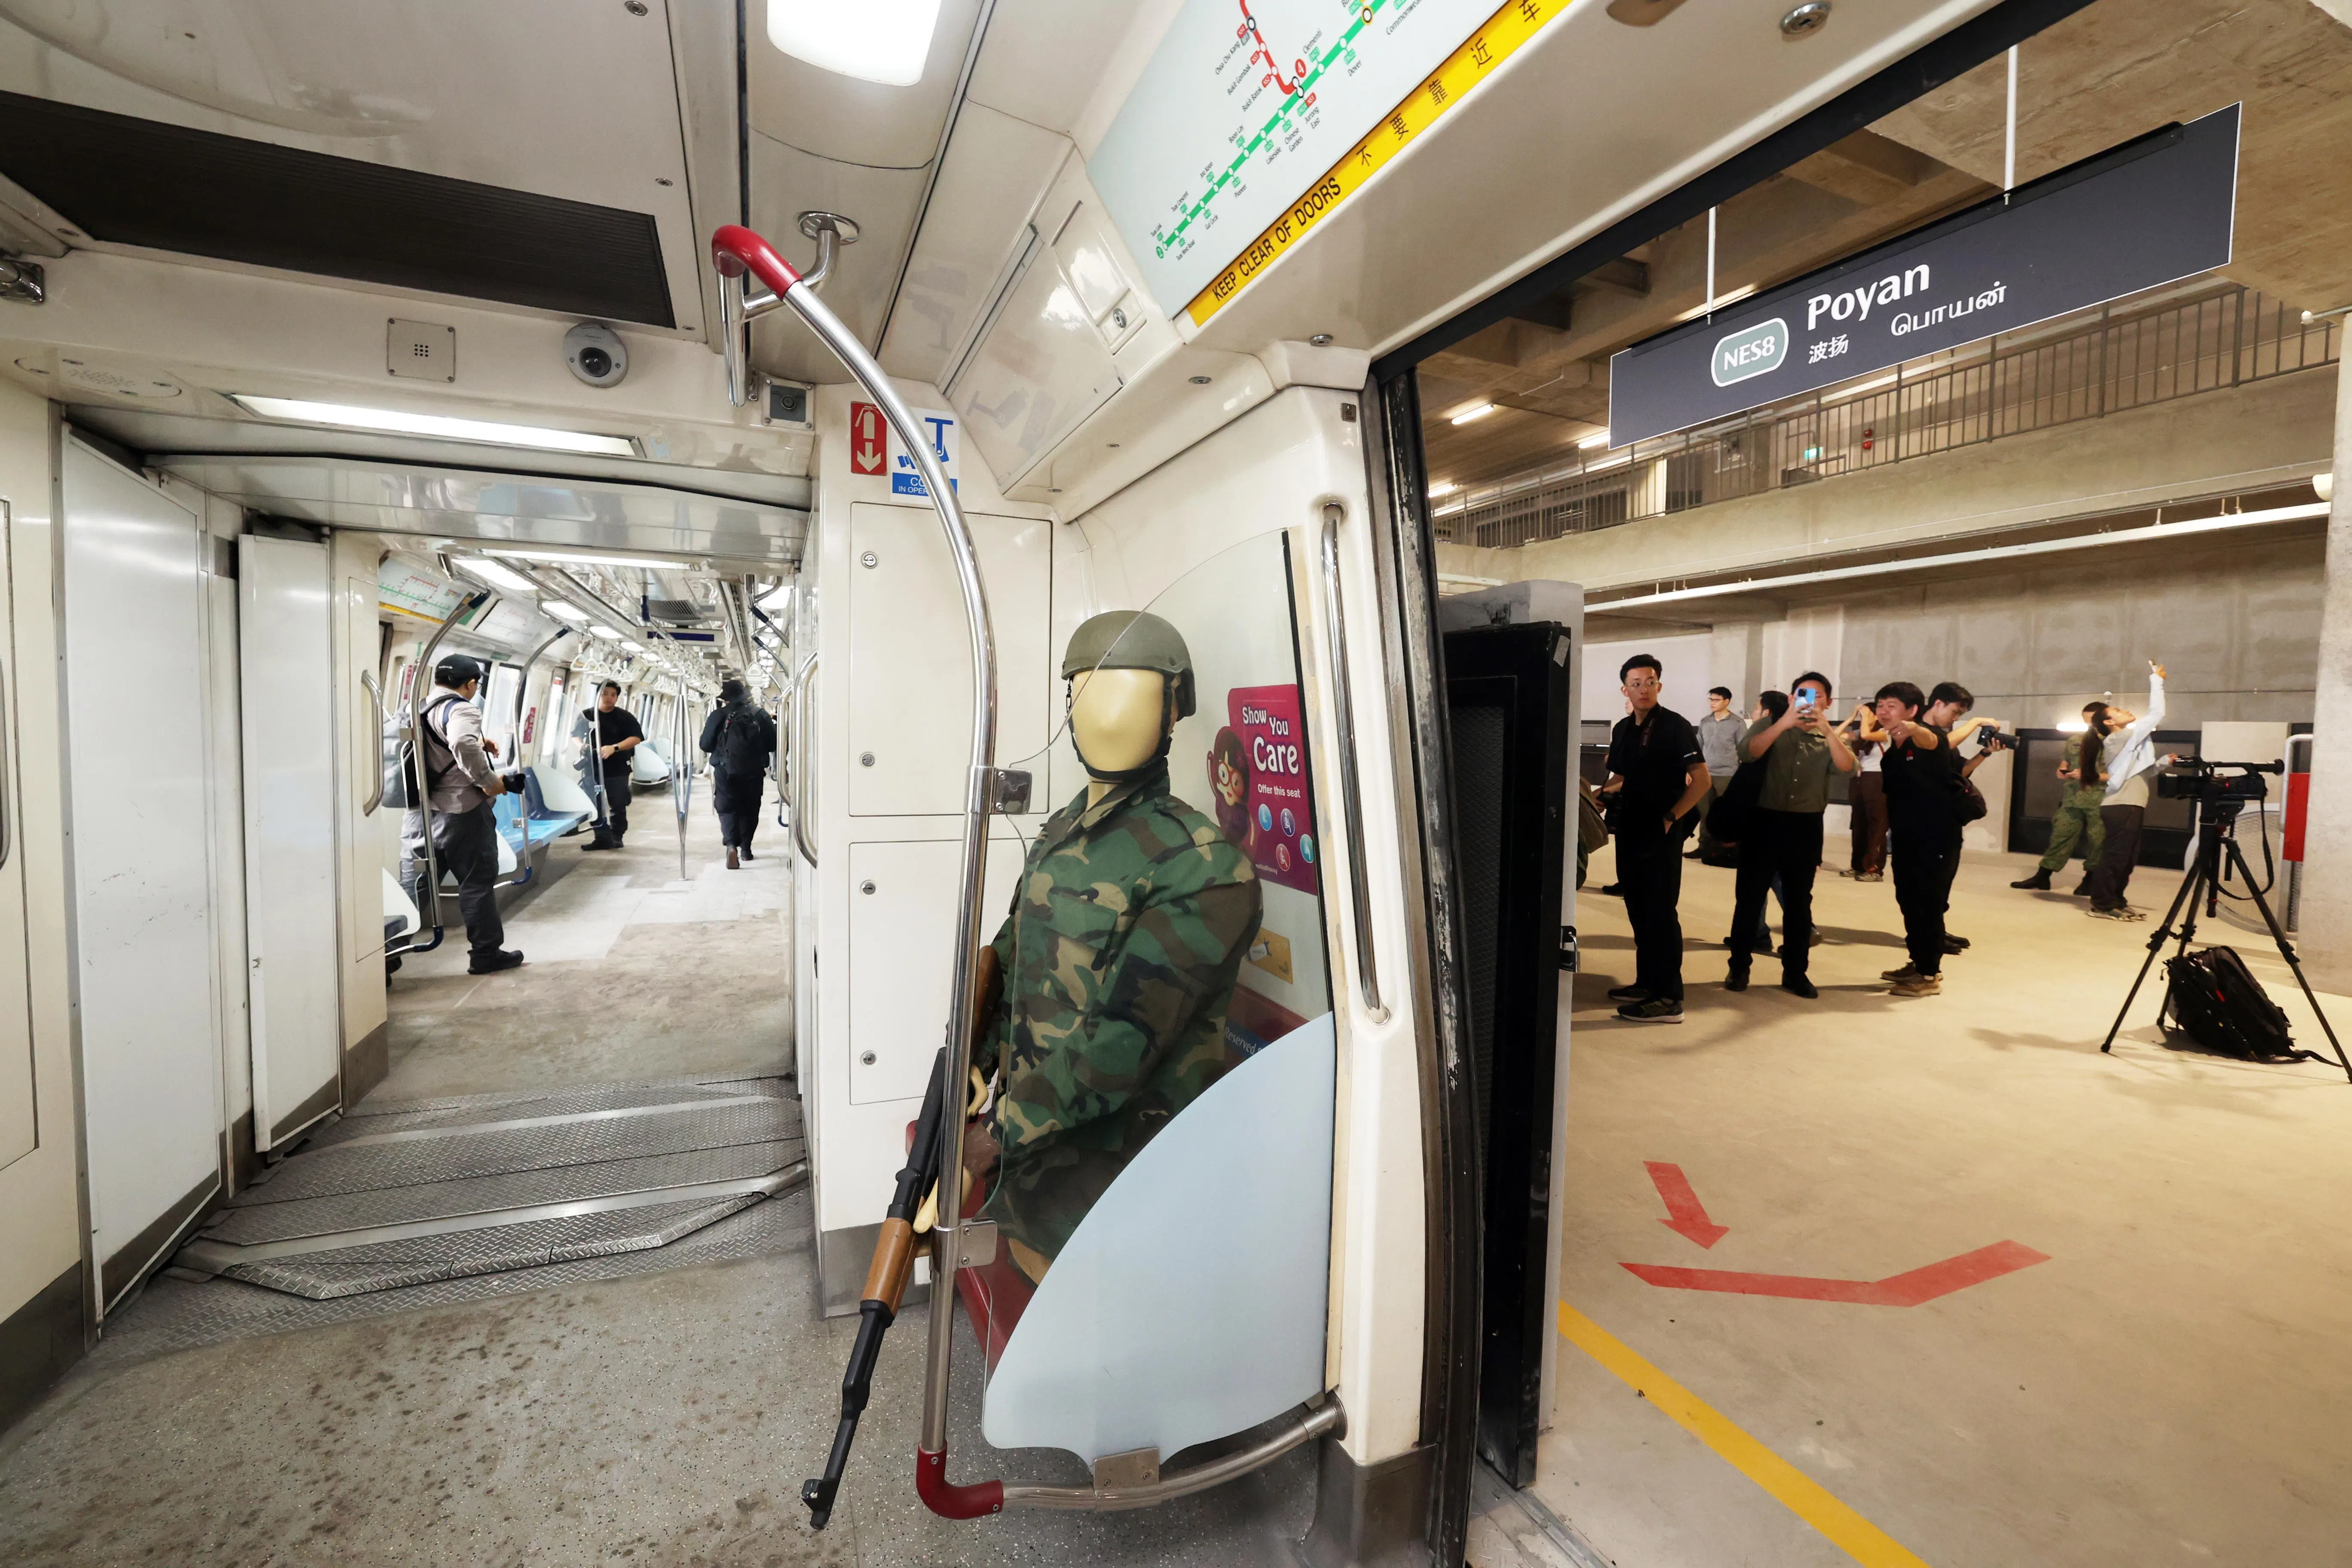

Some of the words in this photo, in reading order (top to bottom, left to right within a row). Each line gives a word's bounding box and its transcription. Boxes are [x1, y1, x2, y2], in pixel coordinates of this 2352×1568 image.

[1230, 41, 1240, 54] Kang
[1303, 28, 1322, 54] Clementi
[1348, 60, 1362, 77] Dover
[1305, 107, 1320, 124] Jurong
[1311, 117, 1320, 129] East
[1285, 128, 1300, 144] Chinese
[1289, 136, 1303, 151] Garden
[1266, 147, 1282, 164] Lakeside
[1212, 271, 1236, 301] KEEP
[1239, 238, 1275, 276] CLEAR
[1276, 219, 1291, 243] OF
[1294, 177, 1341, 226] DOORS
[1808, 264, 1930, 331] Poyan
[1891, 281, 2007, 336] பொயன்
[1724, 335, 1775, 371] NES8
[1808, 334, 1849, 364] 波扬
[1242, 706, 1267, 724] Show
[1269, 717, 1289, 735] You
[1253, 736, 1298, 774] Care
[1258, 784, 1273, 794] Offer
[1274, 786, 1285, 796] this
[1287, 789, 1301, 798] seat
[1225, 1027, 1256, 1055] Reserved
